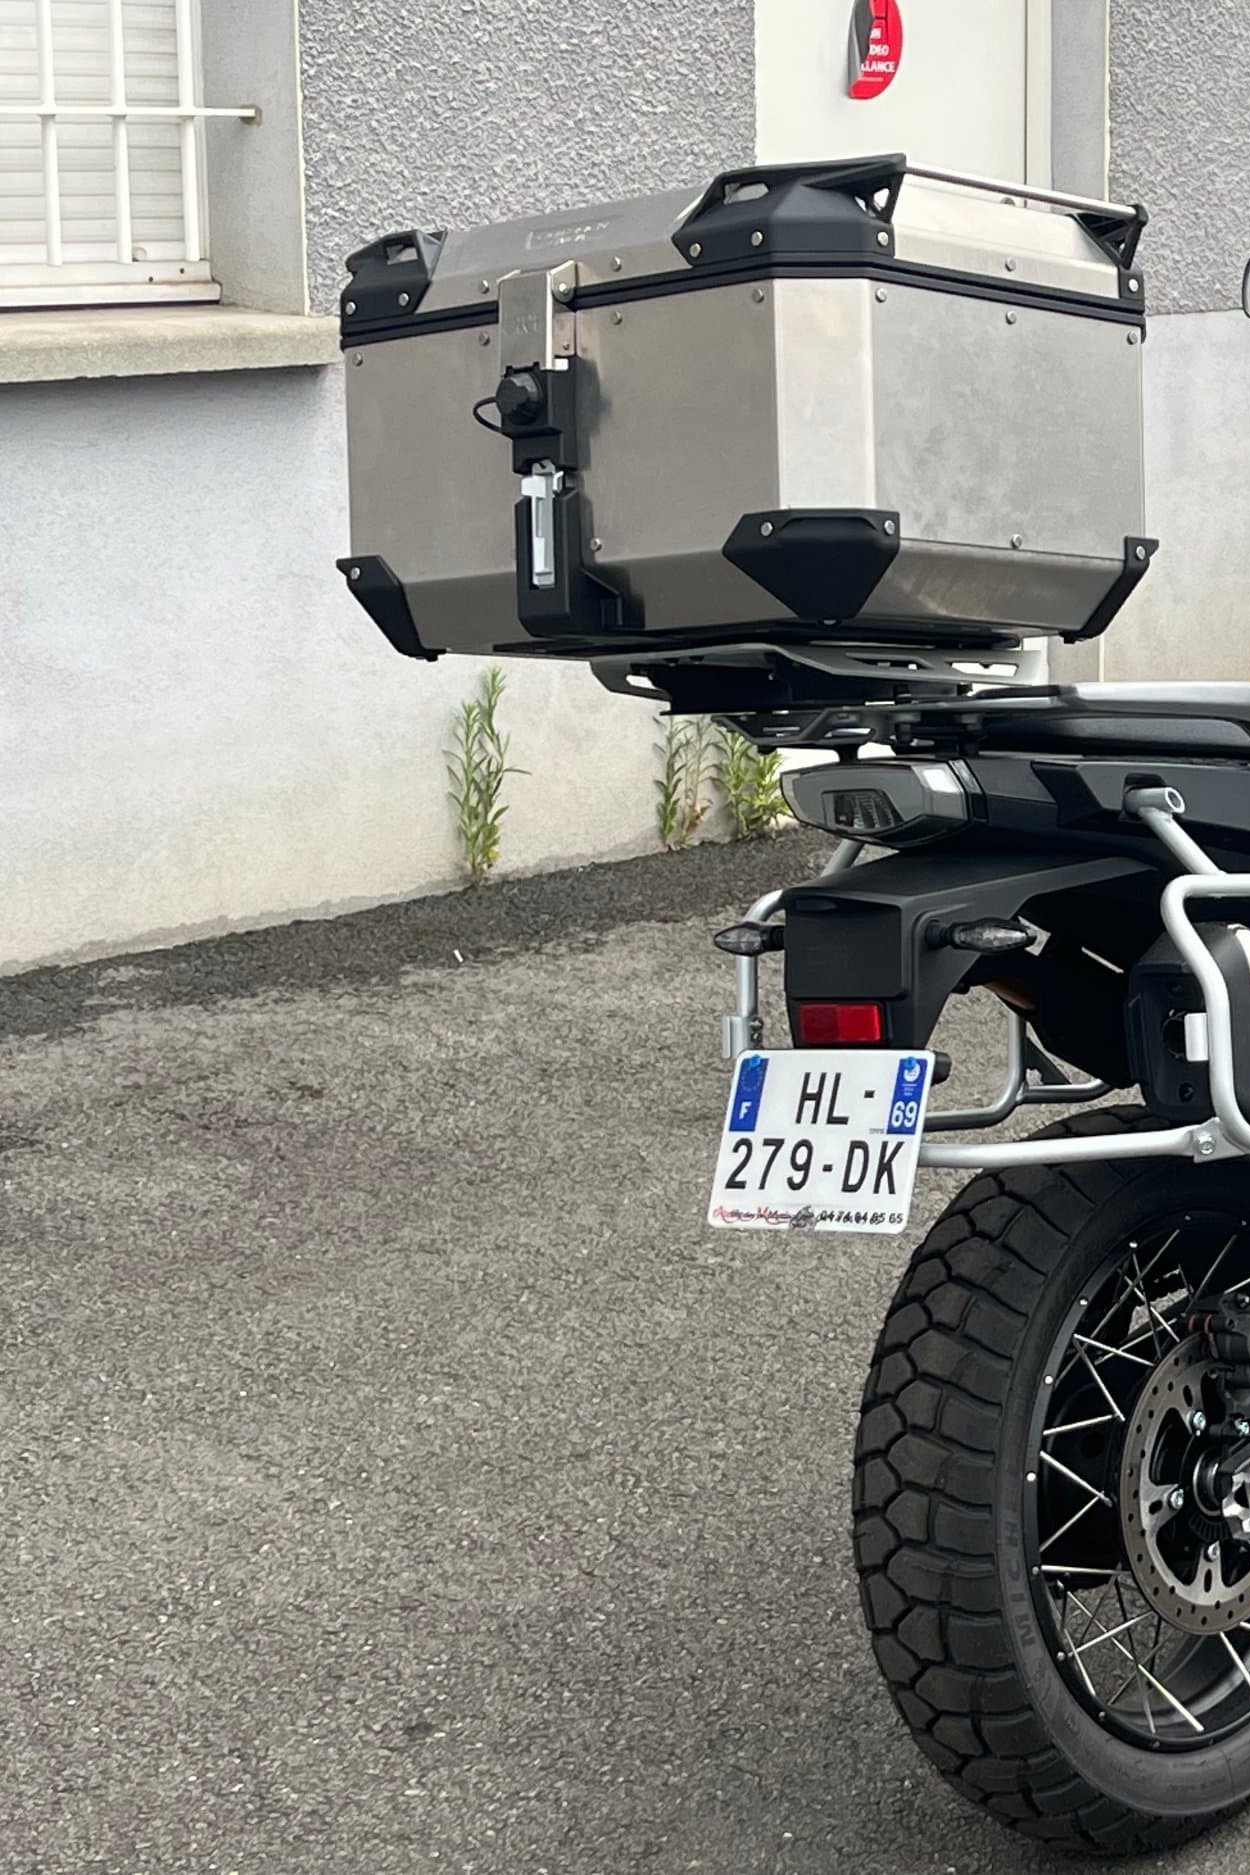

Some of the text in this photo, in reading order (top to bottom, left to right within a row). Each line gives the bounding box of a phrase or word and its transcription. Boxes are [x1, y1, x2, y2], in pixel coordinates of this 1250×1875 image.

[739, 1101, 752, 1120] F
[891, 1101, 918, 1128] 69
[725, 1138, 905, 1195] 279-DK
